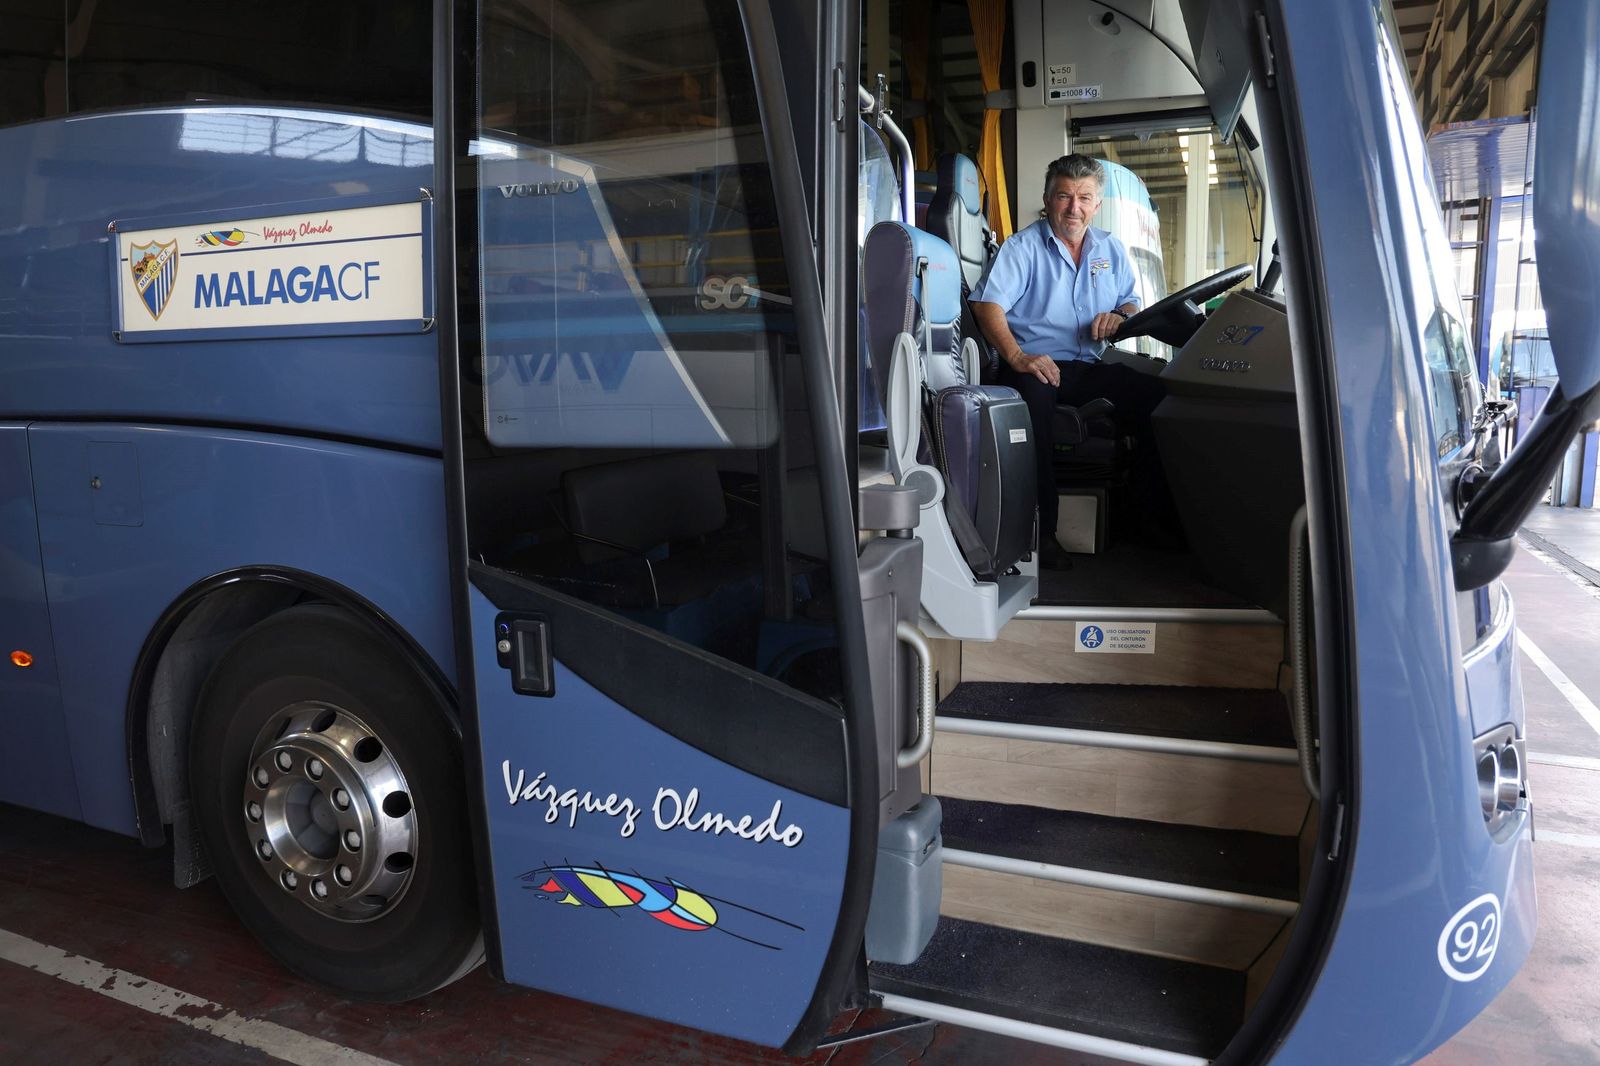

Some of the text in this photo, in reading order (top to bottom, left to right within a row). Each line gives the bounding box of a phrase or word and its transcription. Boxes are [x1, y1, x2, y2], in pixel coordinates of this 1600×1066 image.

[299, 219, 333, 237] Olmedo
[502, 759, 804, 847] Vázquez Olmedo
[1452, 912, 1496, 963] 92
